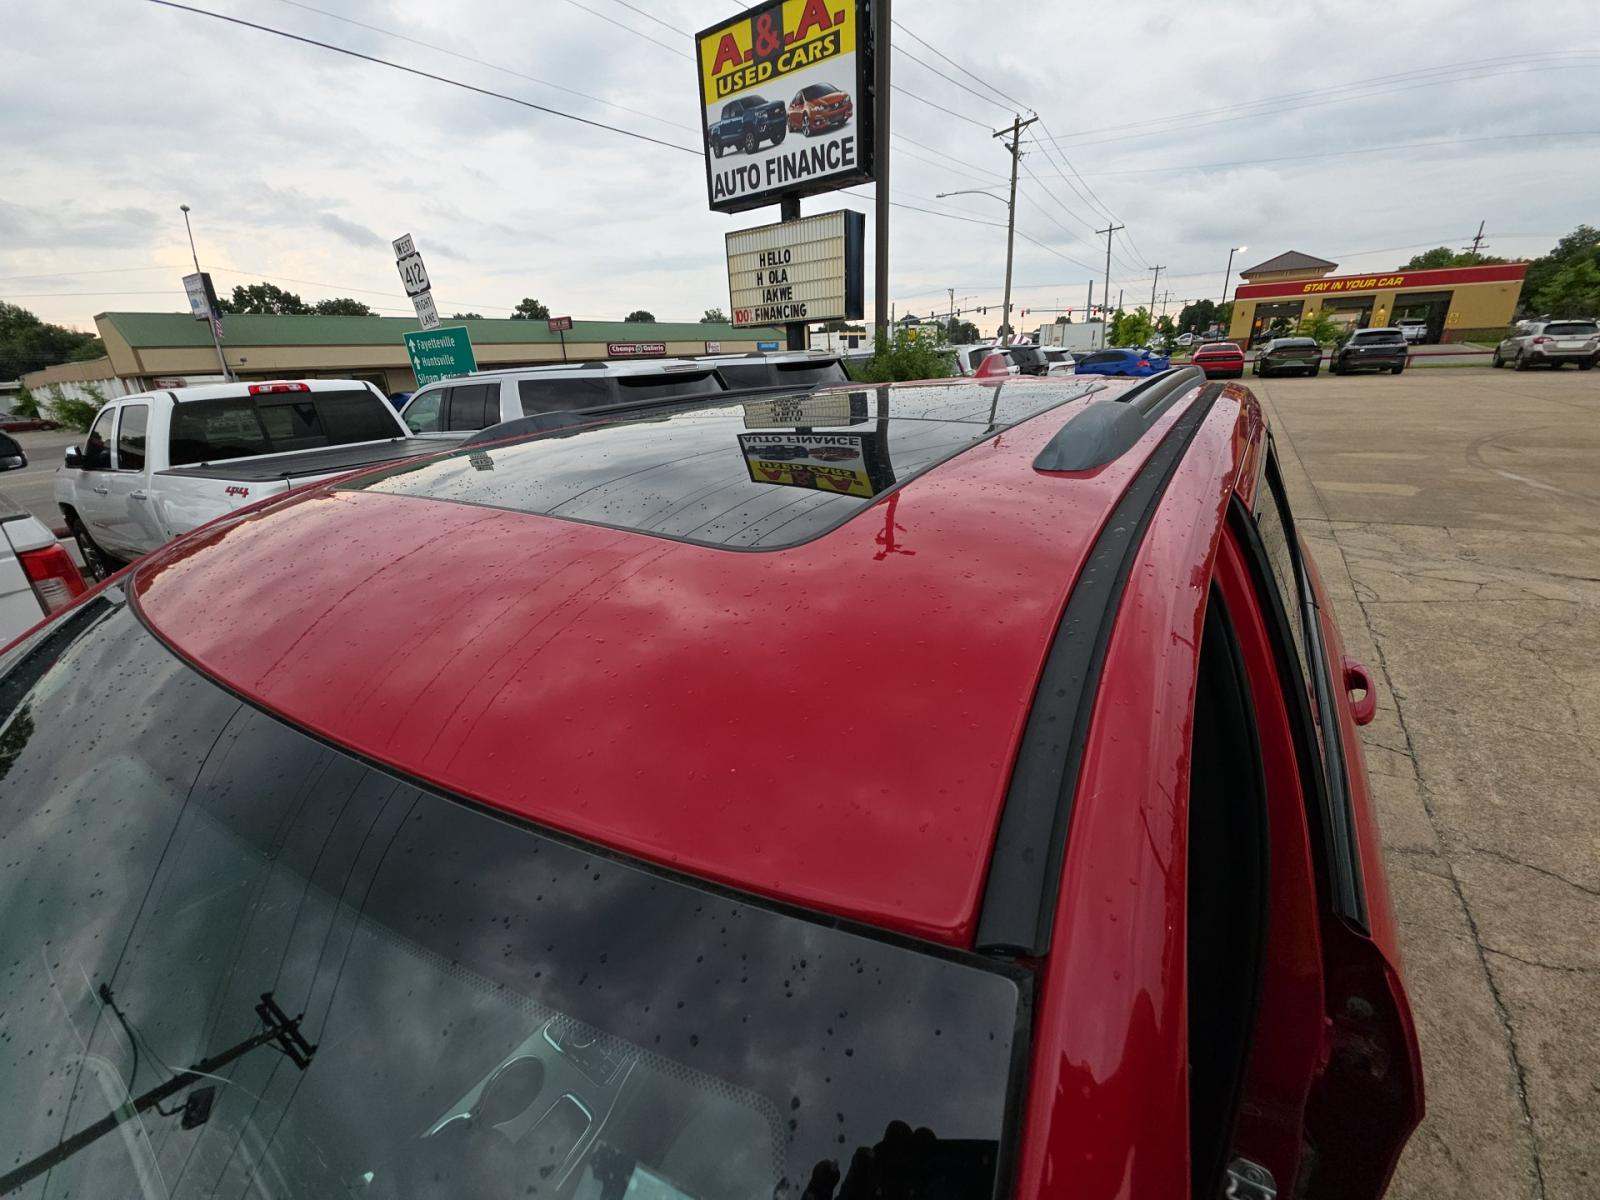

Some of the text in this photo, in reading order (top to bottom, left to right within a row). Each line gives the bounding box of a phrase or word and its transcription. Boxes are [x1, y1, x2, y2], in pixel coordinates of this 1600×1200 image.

[718, 35, 836, 95] USED CARS
[714, 136, 855, 199] AUTO FINANCE
[396, 239, 412, 255] WEST
[759, 249, 791, 267] HELLO
[406, 262, 425, 287] 412
[1303, 276, 1404, 293] STAY IN YOUR CAR
[421, 313, 439, 326] LANE
[755, 303, 807, 321] FINANCING
[416, 336, 456, 352] Fayetteville
[421, 354, 455, 367] Huntsville
[417, 373, 439, 384] Siloam
